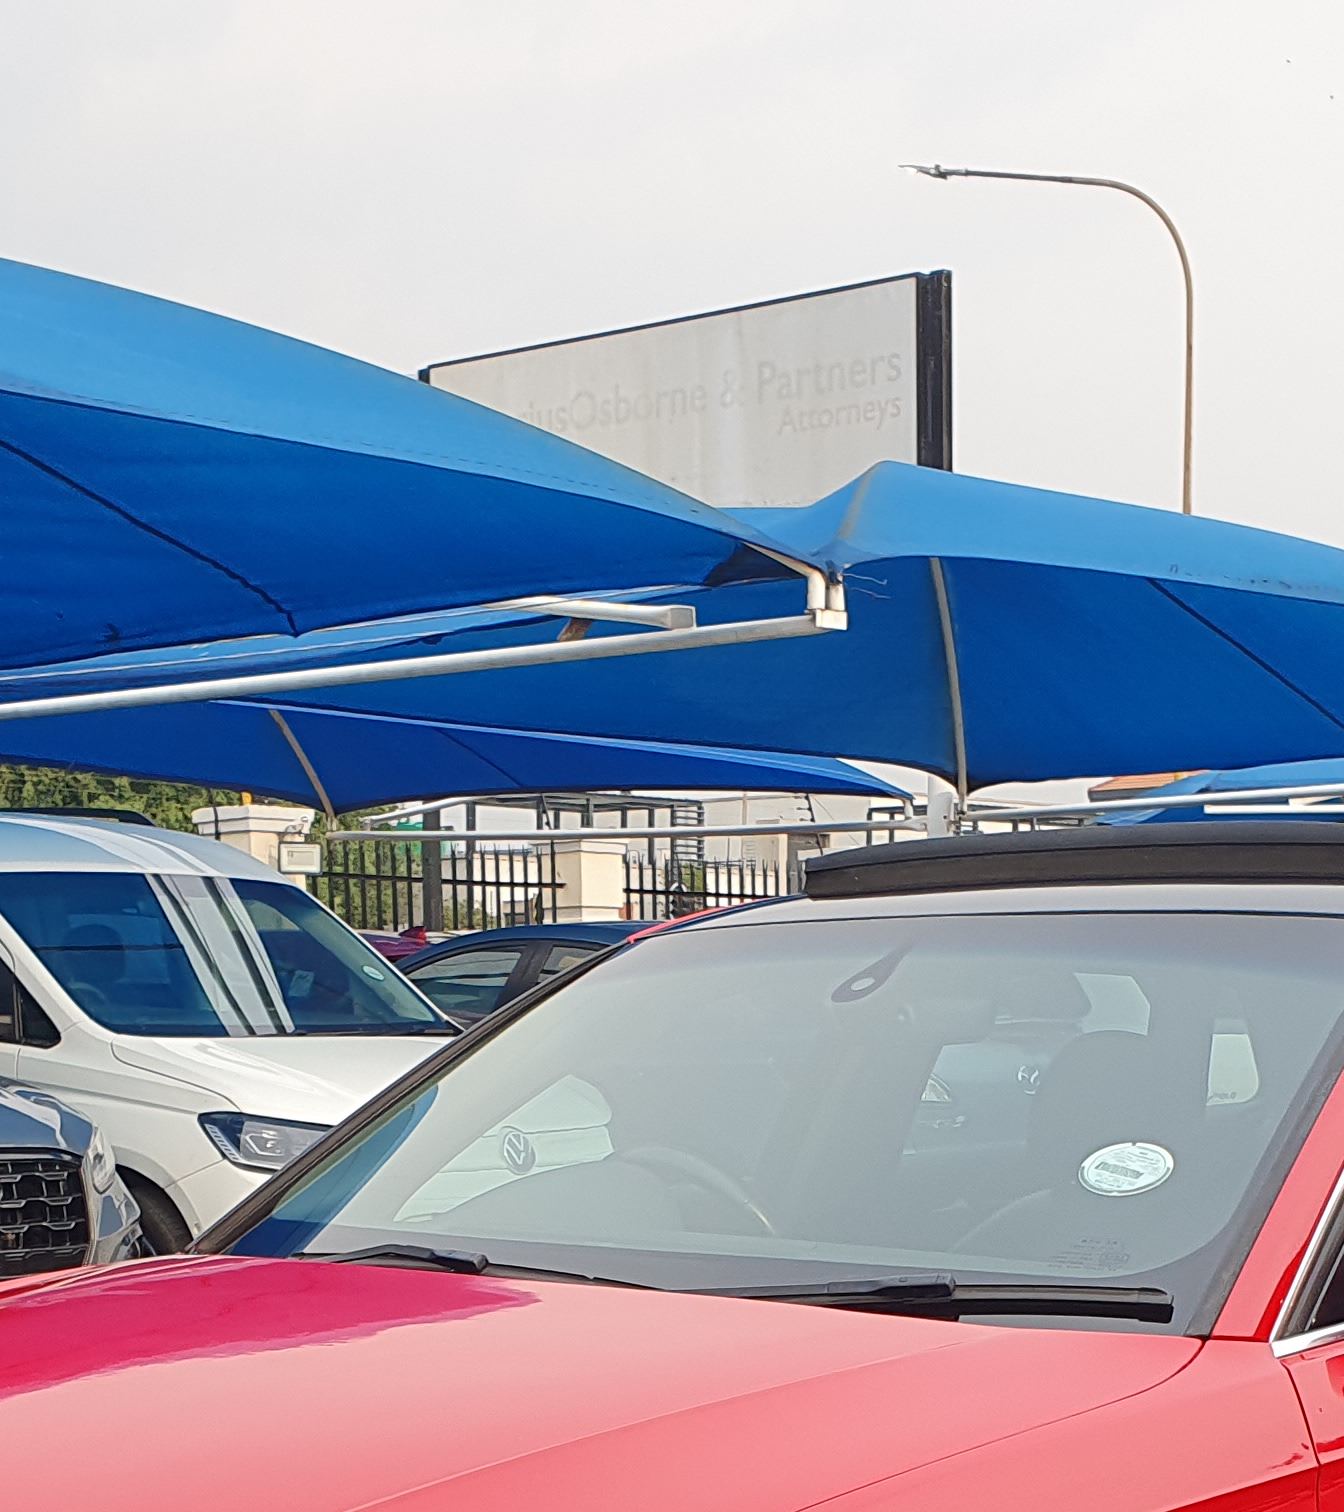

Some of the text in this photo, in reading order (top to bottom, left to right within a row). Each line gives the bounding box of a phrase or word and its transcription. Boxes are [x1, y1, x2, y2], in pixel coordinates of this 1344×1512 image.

[720, 369, 745, 409] &
[756, 352, 903, 404] Partners
[777, 396, 903, 437] Attorneys
